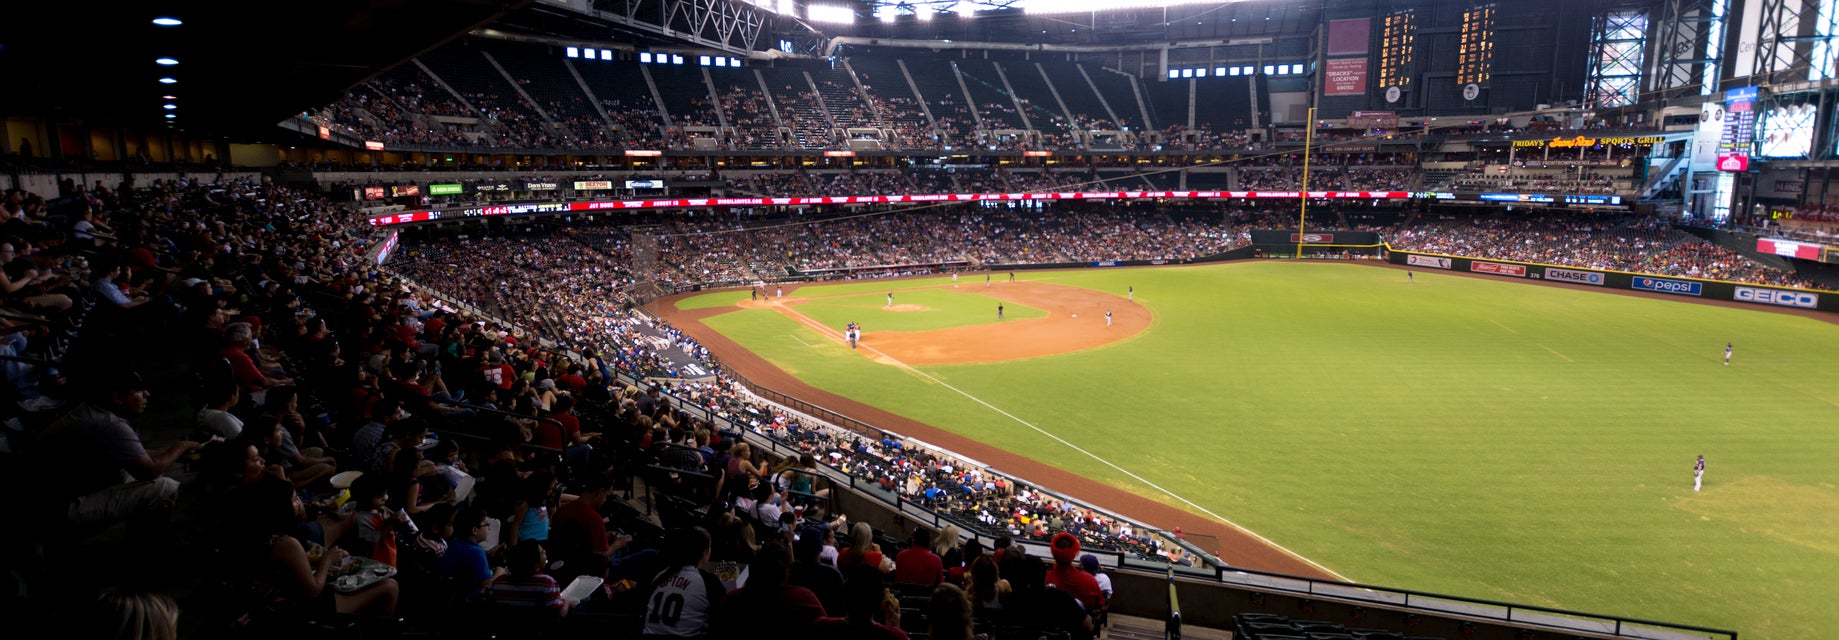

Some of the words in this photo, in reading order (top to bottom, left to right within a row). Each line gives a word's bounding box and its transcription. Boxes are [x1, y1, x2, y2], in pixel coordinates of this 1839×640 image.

[1550, 270, 1587, 280] CHASE
[1654, 280, 1691, 292] pepsi
[1735, 288, 1817, 308] GEICO
[649, 592, 684, 627] 10
